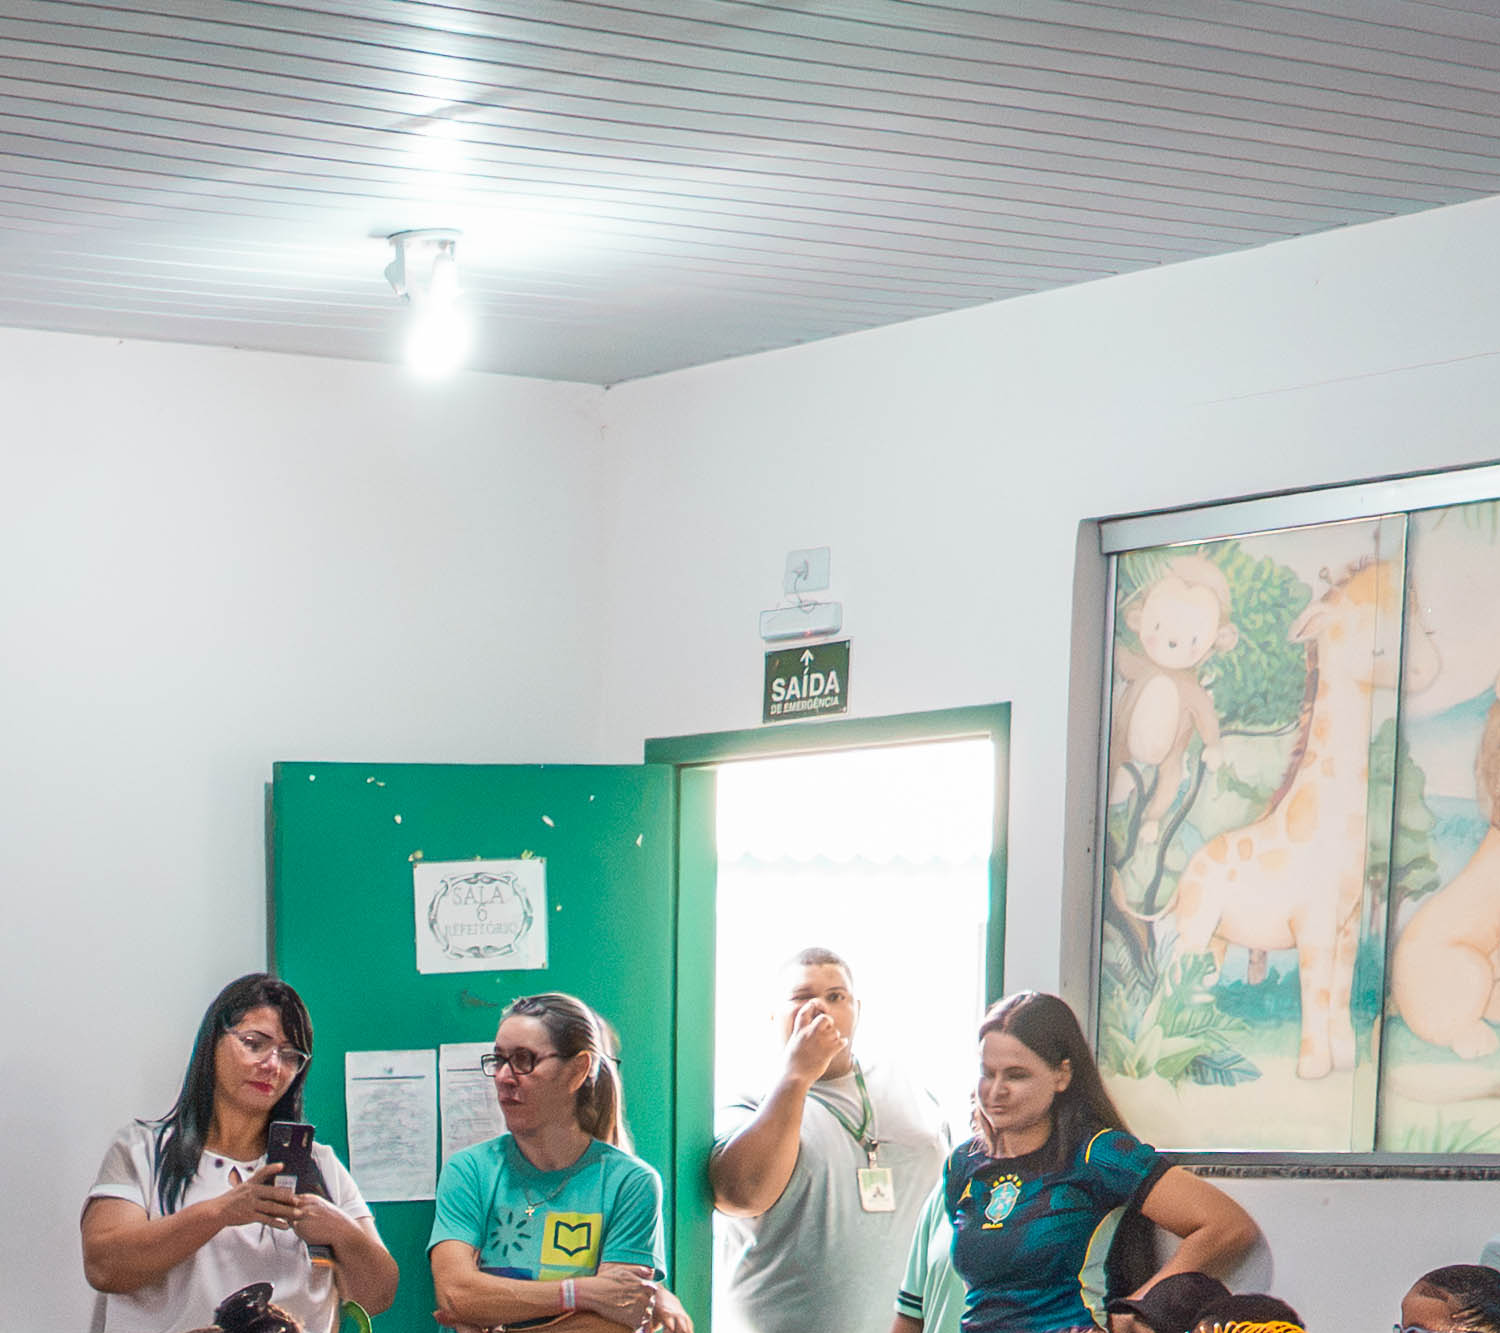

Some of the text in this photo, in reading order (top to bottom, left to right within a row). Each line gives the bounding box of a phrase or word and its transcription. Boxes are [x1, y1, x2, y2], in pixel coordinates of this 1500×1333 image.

[771, 667, 840, 701] SAÍDA
[770, 695, 840, 715] DE EMERGÊNCIA
[452, 886, 504, 905] SALA
